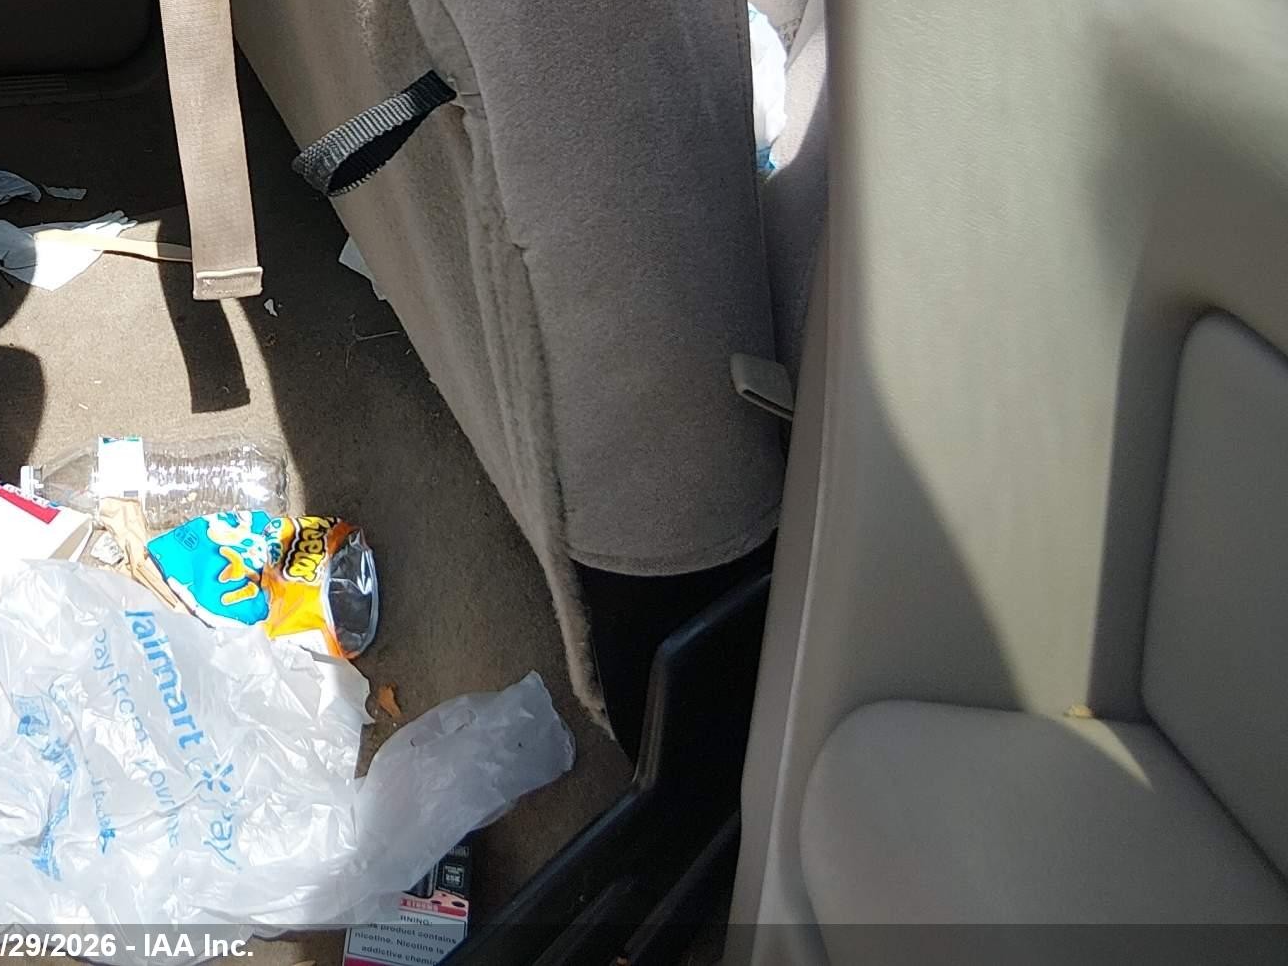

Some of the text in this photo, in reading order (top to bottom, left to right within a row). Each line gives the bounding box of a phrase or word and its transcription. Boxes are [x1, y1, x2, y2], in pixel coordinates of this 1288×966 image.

[288, 515, 339, 582] heetos
[354, 932, 393, 944] nicotine.
[396, 939, 434, 953] Nicotine
[380, 924, 416, 936] product
[418, 931, 457, 944] contains
[361, 945, 403, 959] addictive
